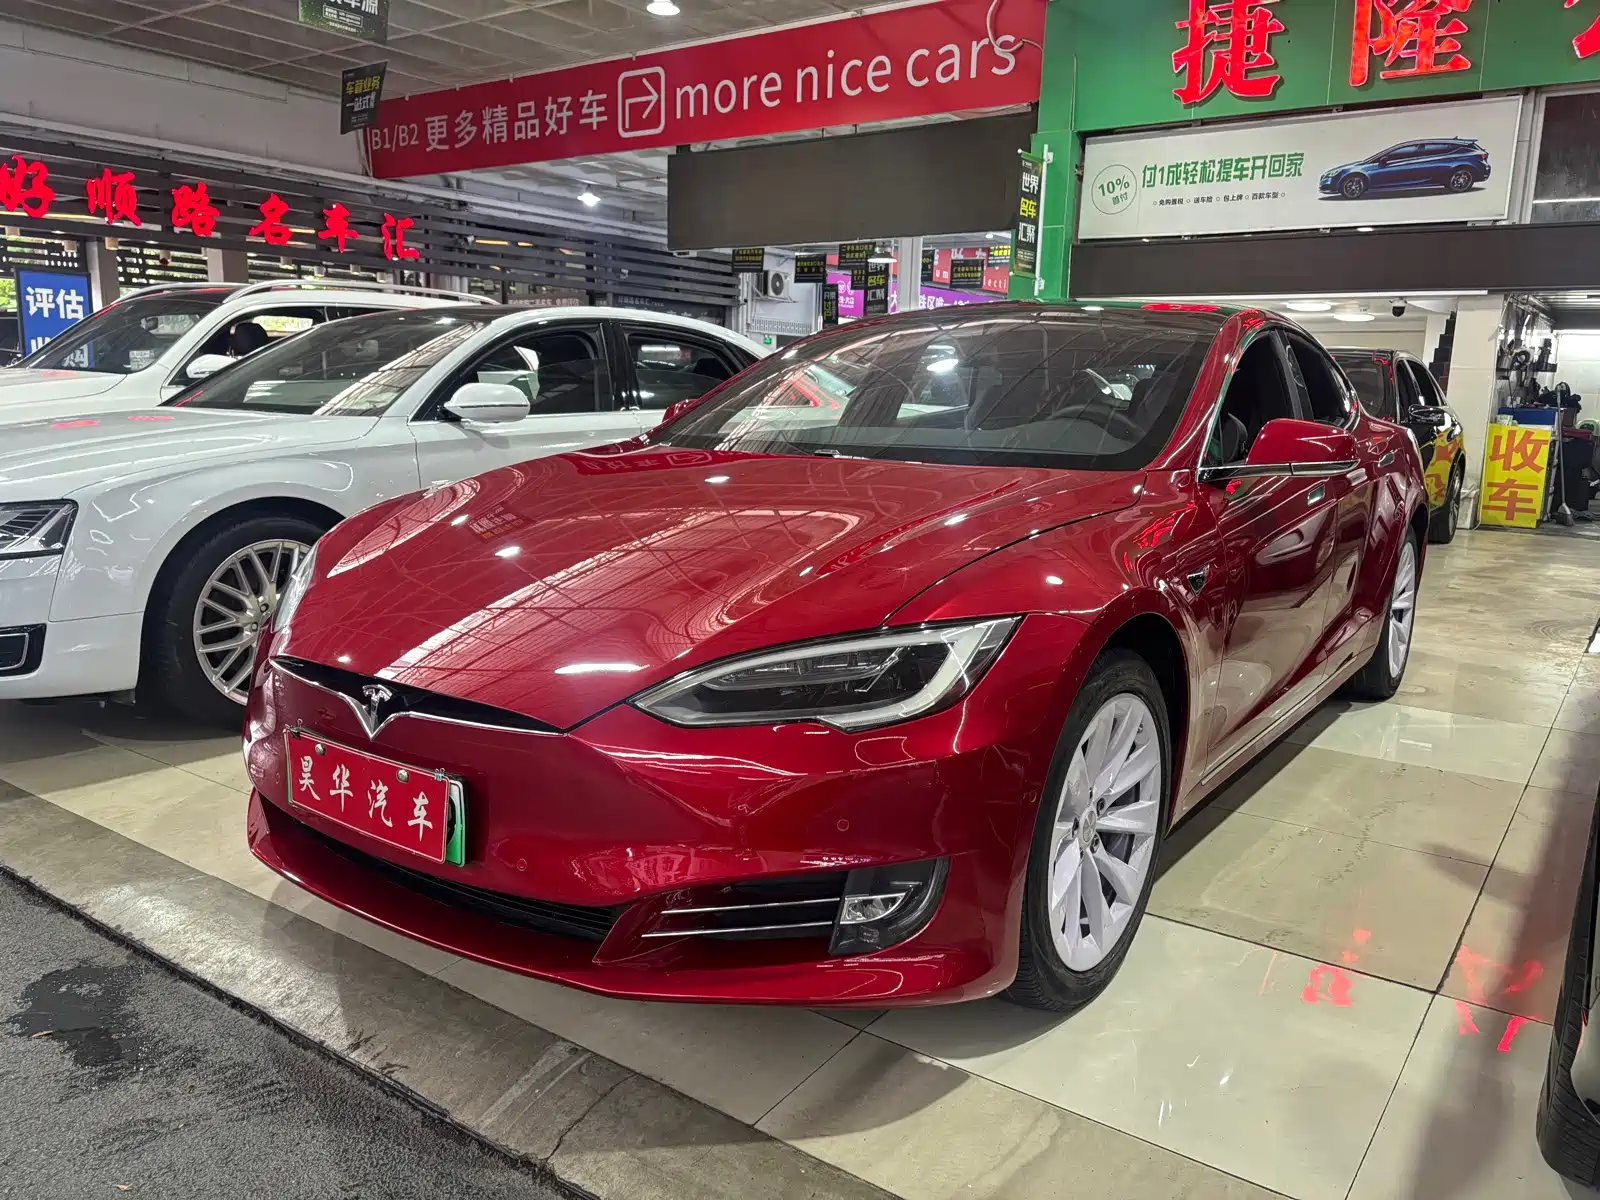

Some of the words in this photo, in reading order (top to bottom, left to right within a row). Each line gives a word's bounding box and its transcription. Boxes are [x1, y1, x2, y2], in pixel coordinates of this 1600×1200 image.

[372, 124, 419, 152] B1/B2
[425, 90, 608, 152] 更多精品好车
[676, 70, 782, 119] more
[795, 50, 892, 103] nice
[906, 34, 1017, 86] cars
[1021, 171, 1039, 195] 世界
[1098, 175, 1130, 197] 10%
[1142, 153, 1305, 188] 付1成轻松提车开回家
[1020, 196, 1037, 219] 名车
[1018, 221, 1036, 244] 汇聚
[26, 286, 84, 319] 评估
[1482, 430, 1549, 521] 收车
[299, 756, 433, 842] 昊华汽车
